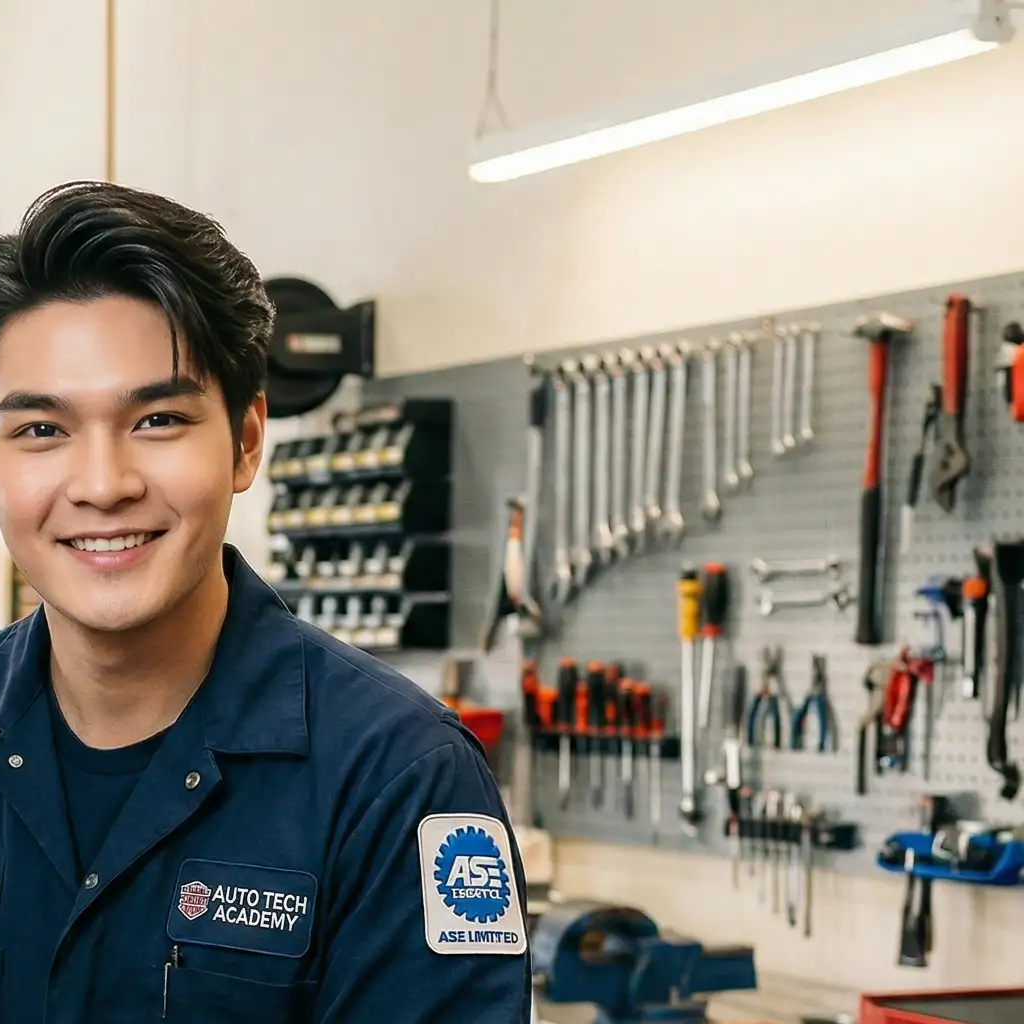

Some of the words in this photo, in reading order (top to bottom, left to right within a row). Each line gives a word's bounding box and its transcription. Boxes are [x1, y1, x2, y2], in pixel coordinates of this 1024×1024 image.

[211, 885, 260, 907] AUTO
[262, 891, 308, 914] TECH
[212, 905, 299, 932] ACADEMY
[437, 930, 466, 943] ASE
